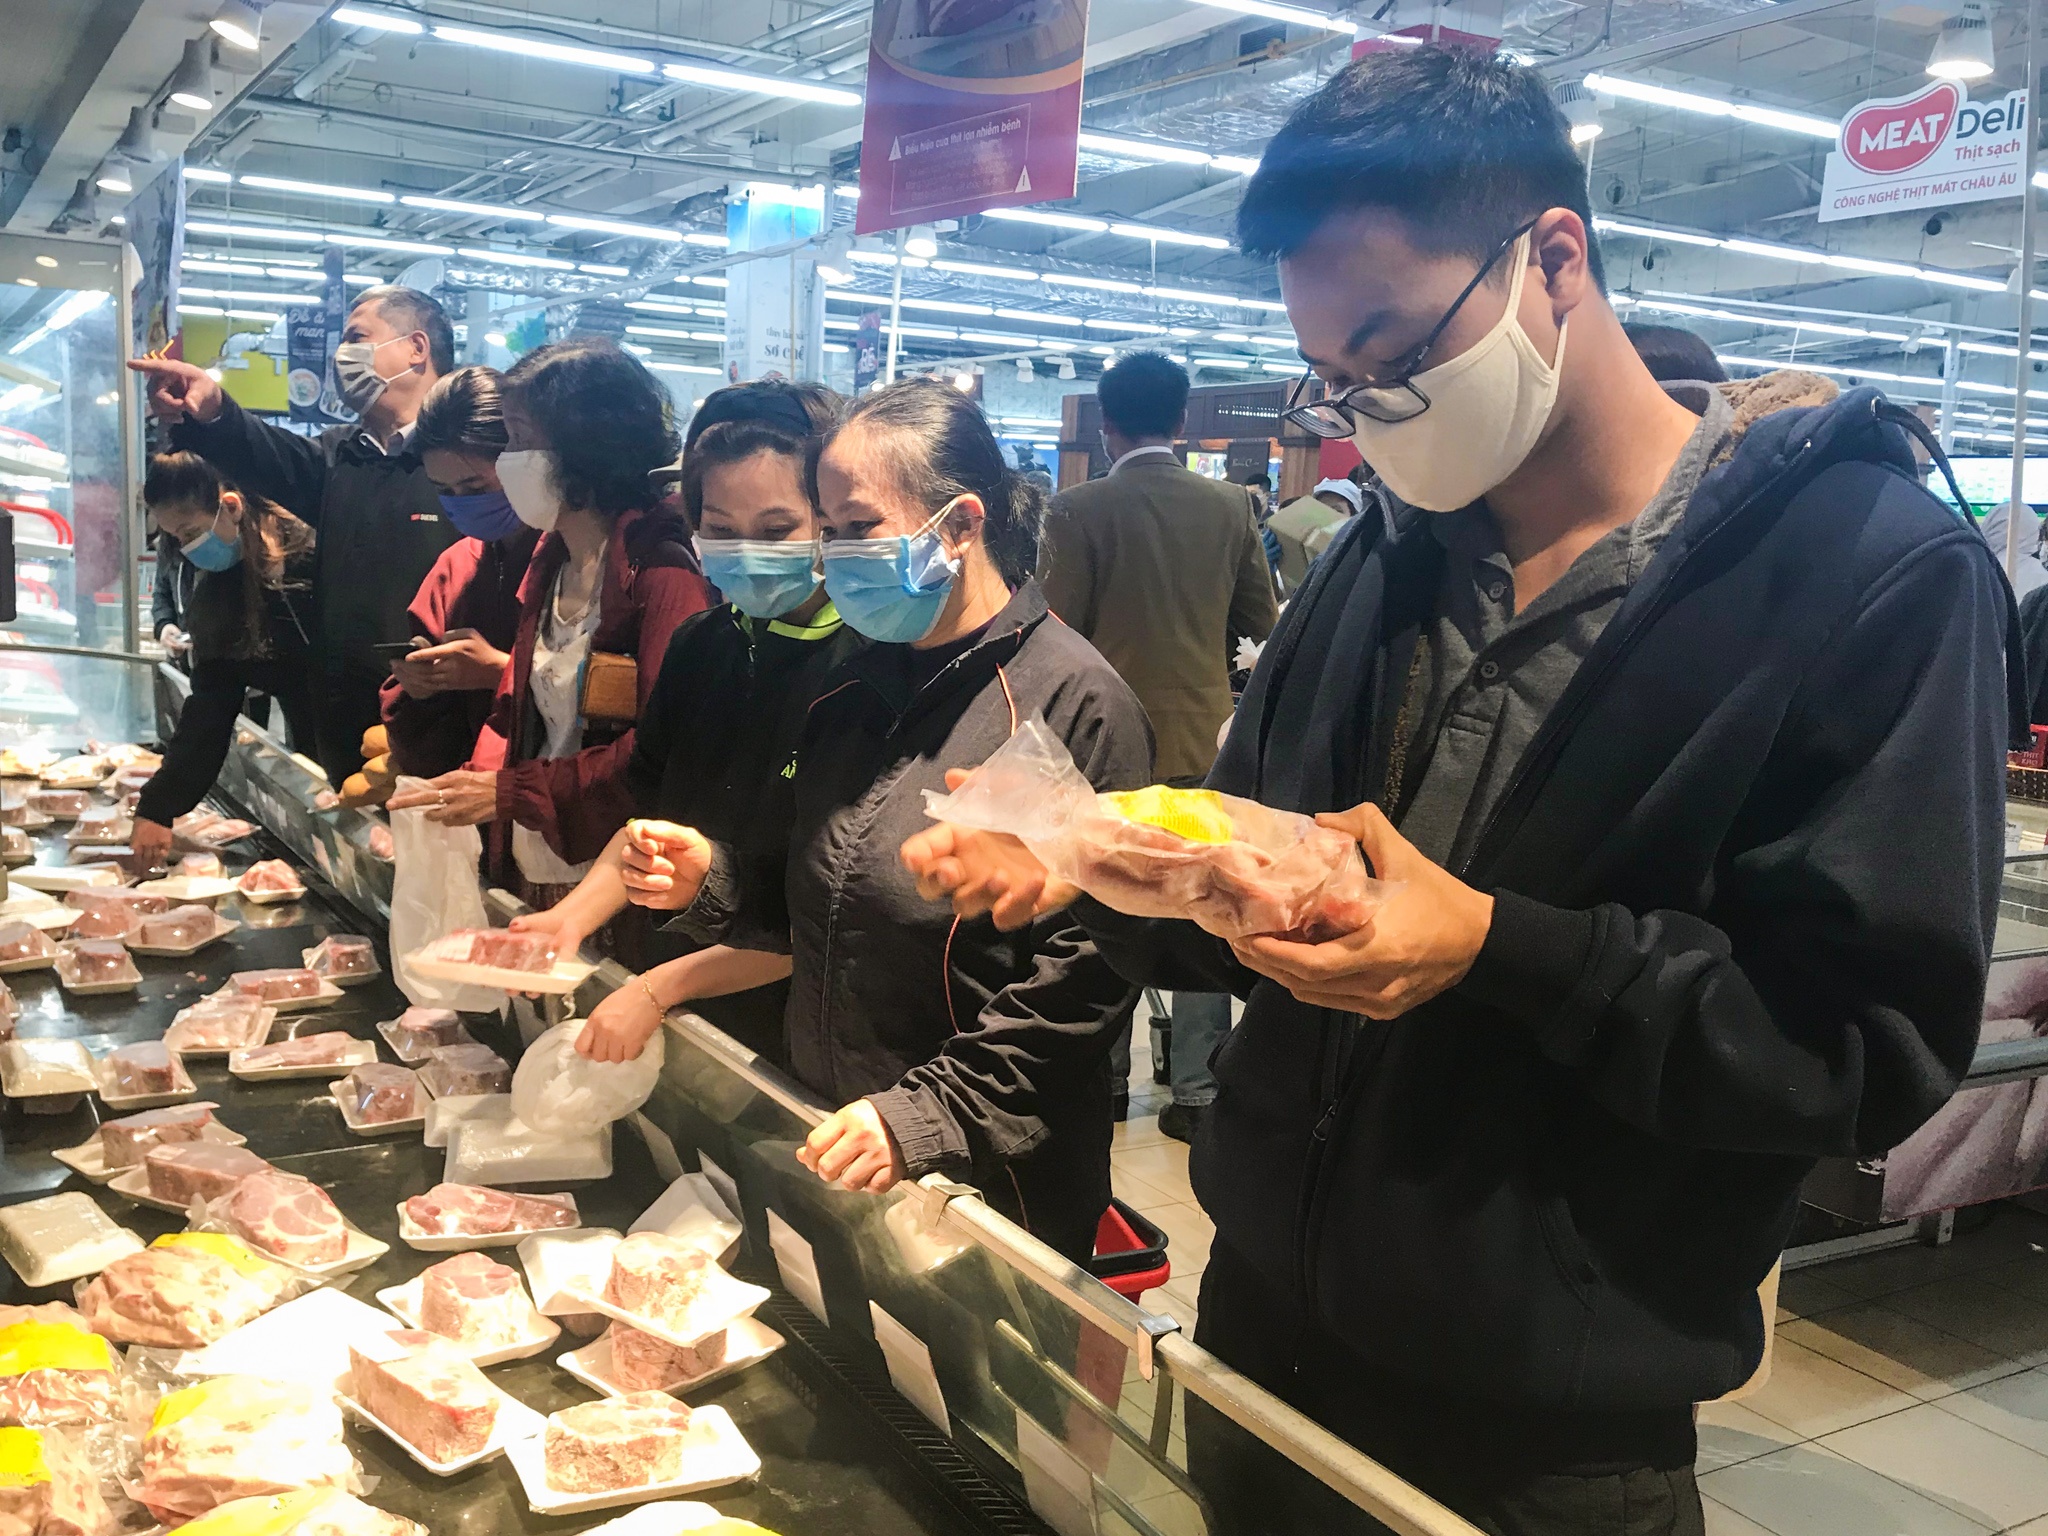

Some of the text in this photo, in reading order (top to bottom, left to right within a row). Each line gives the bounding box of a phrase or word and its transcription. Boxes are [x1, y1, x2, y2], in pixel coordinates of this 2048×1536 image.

[976, 121, 1000, 138] nhiễm
[1001, 118, 1022, 135] bệnh
[1859, 96, 2026, 155] MEAT Deli
[1954, 138, 2021, 162] Thịt sạch
[1833, 172, 2018, 210] CÔNG NGHỆ THỊT MÁT CHÂU ÂU
[295, 327, 325, 338] man
